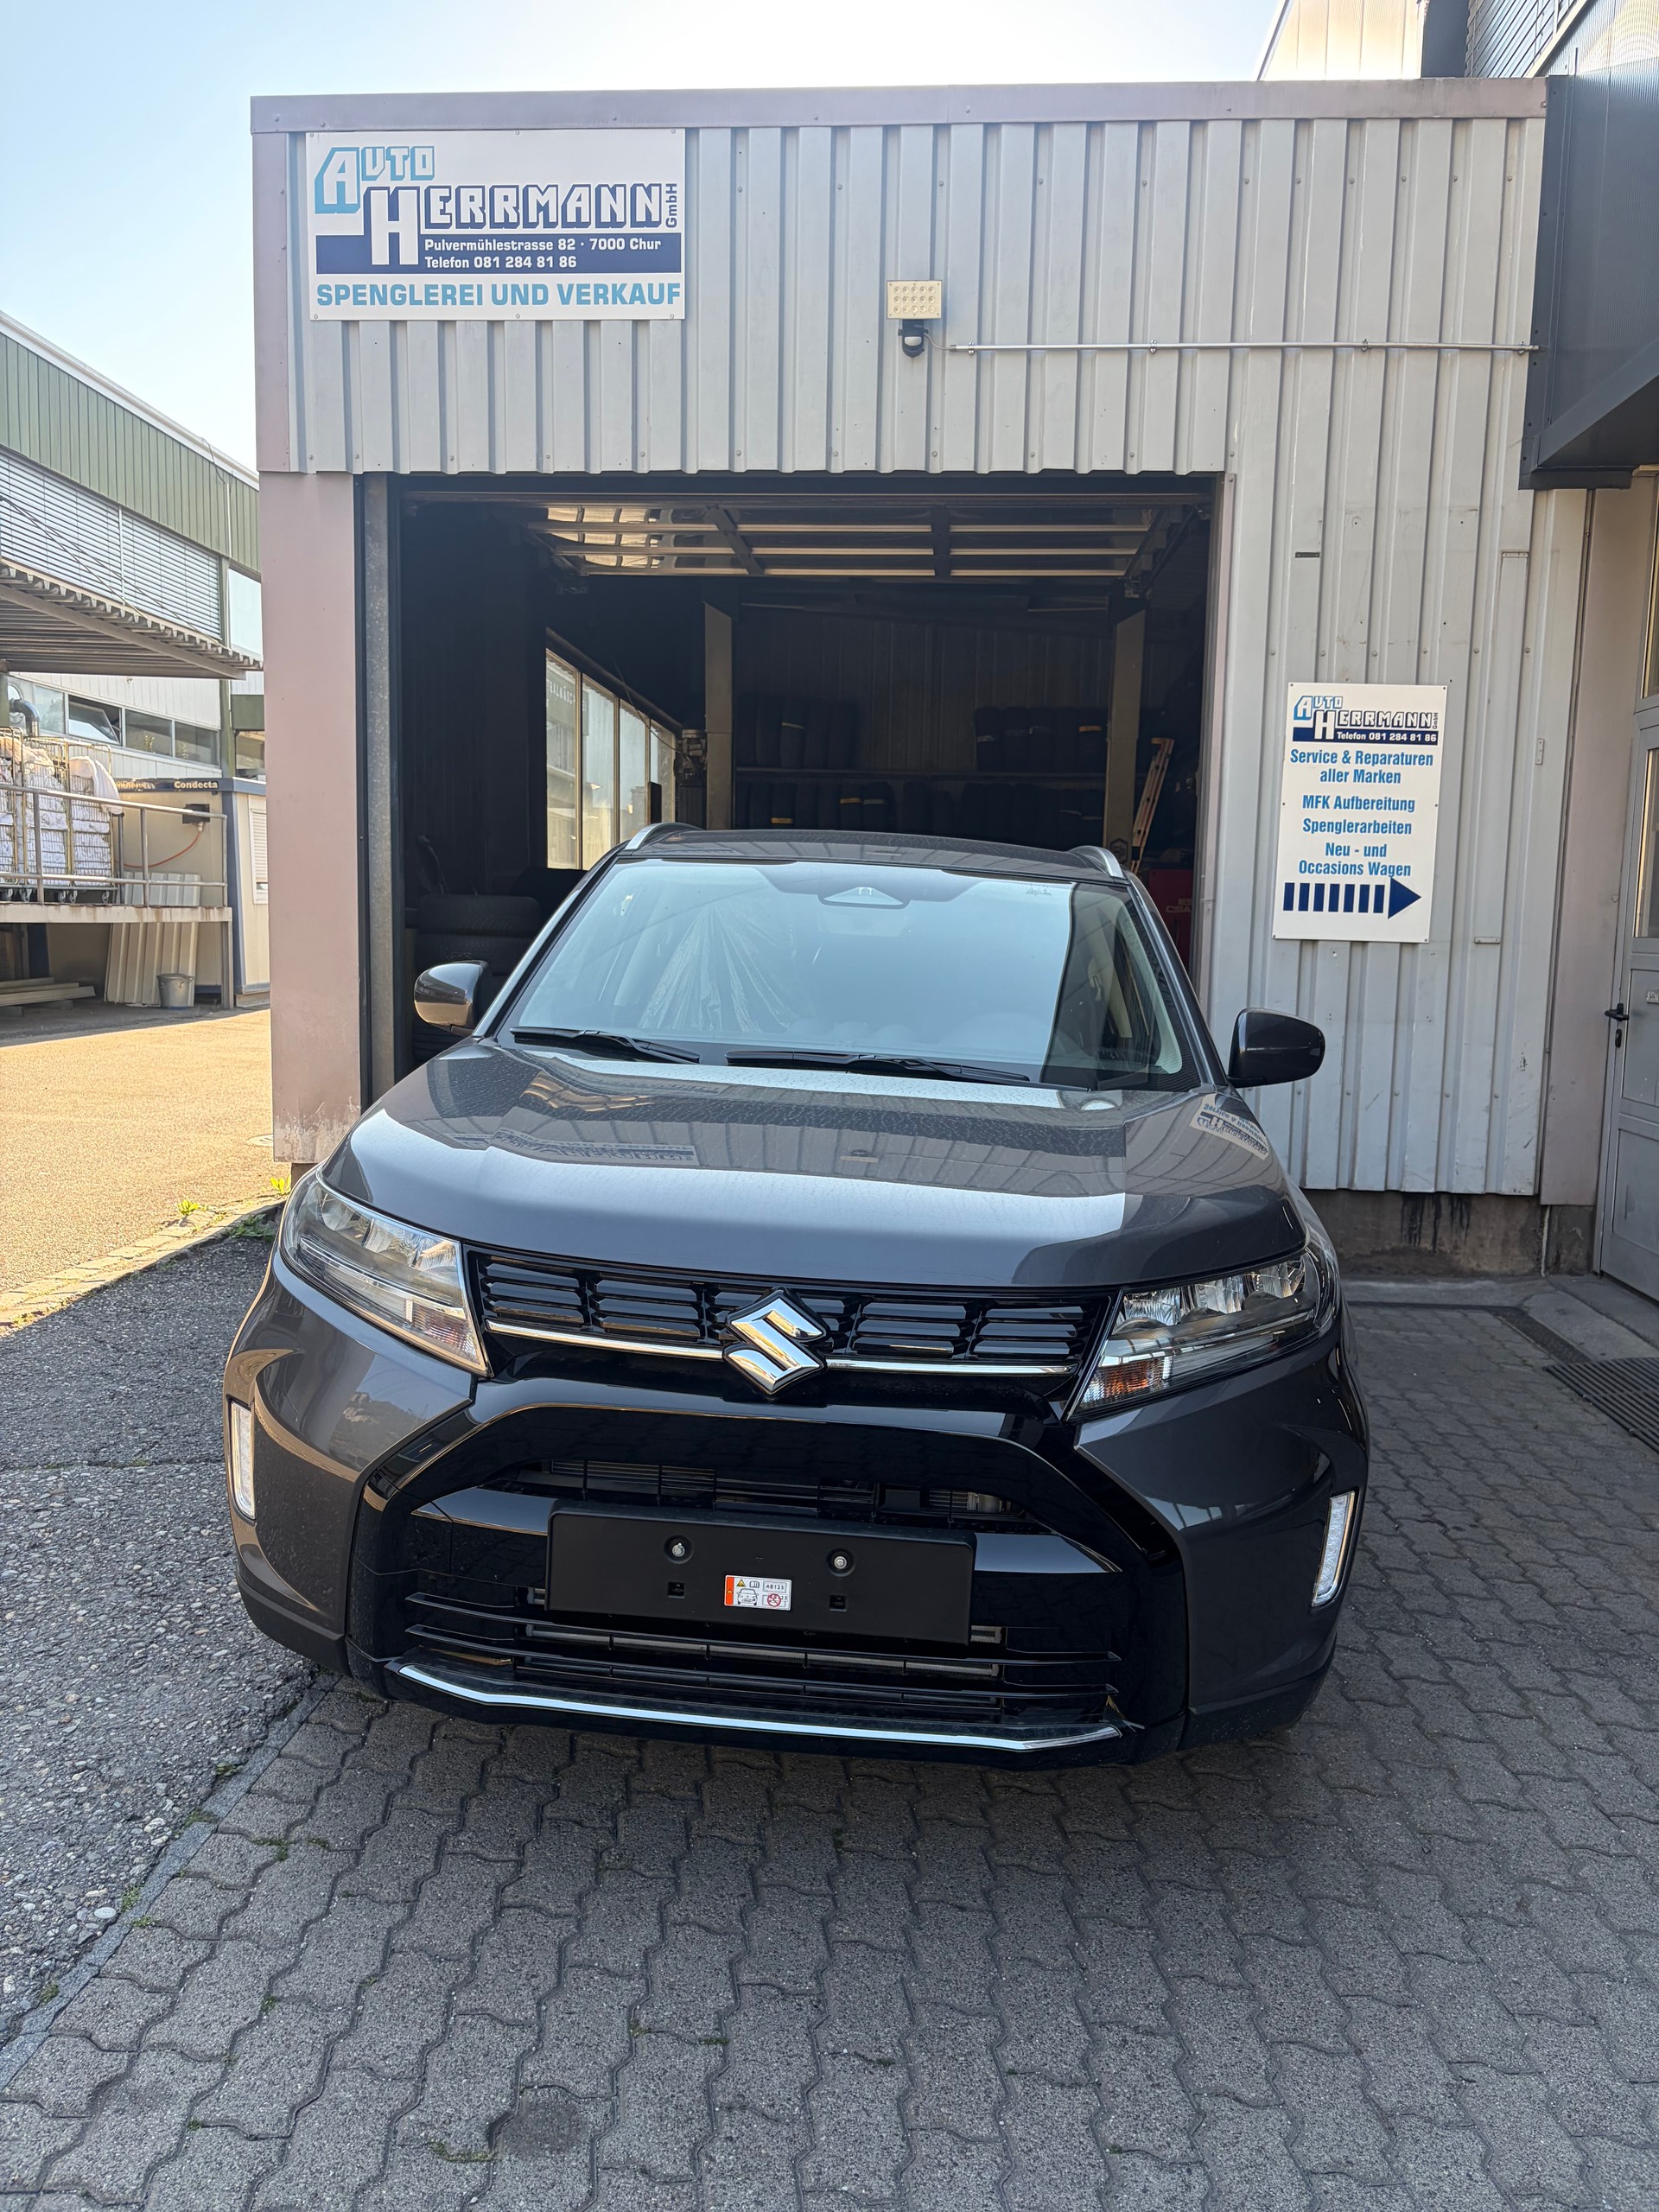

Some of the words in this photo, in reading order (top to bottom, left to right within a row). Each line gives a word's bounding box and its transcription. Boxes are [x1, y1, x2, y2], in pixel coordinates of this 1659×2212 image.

[315, 145, 435, 214] AUTO
[363, 182, 663, 266] HERRMANN
[665, 182, 677, 229] GmbH
[424, 238, 554, 251] Pulvermühlestrasse
[557, 238, 575, 251] 82
[589, 238, 626, 251] 7000
[629, 238, 662, 250] Chur
[424, 256, 470, 268] Telefon
[474, 256, 500, 269] 081
[505, 256, 532, 268] 284
[537, 256, 554, 268] 81
[558, 256, 577, 268] 86
[316, 283, 483, 306] SPENGLEREI
[491, 283, 549, 306] UND
[556, 283, 681, 305] VERKAUF
[1313, 709, 1433, 741] HERRMANN
[1337, 731, 1366, 741] Telefon
[1368, 732, 1387, 741] 081
[1389, 733, 1408, 741] 284
[1409, 733, 1422, 741] 81
[1424, 734, 1437, 742] 86
[1290, 749, 1338, 764] Service
[1341, 749, 1351, 765] &
[1354, 750, 1433, 766] Reparaturen
[174, 780, 219, 789] Condecta
[1319, 768, 1350, 783] aller
[1352, 768, 1402, 784] Marken
[1302, 794, 1331, 810] MFK
[1333, 795, 1415, 813] Aufbereitung
[1302, 818, 1413, 835] Spenglerarbeiten
[1325, 842, 1351, 857] Neu
[1363, 843, 1388, 858] und
[1299, 860, 1364, 875] Occasions
[1367, 861, 1412, 878] Wagen
